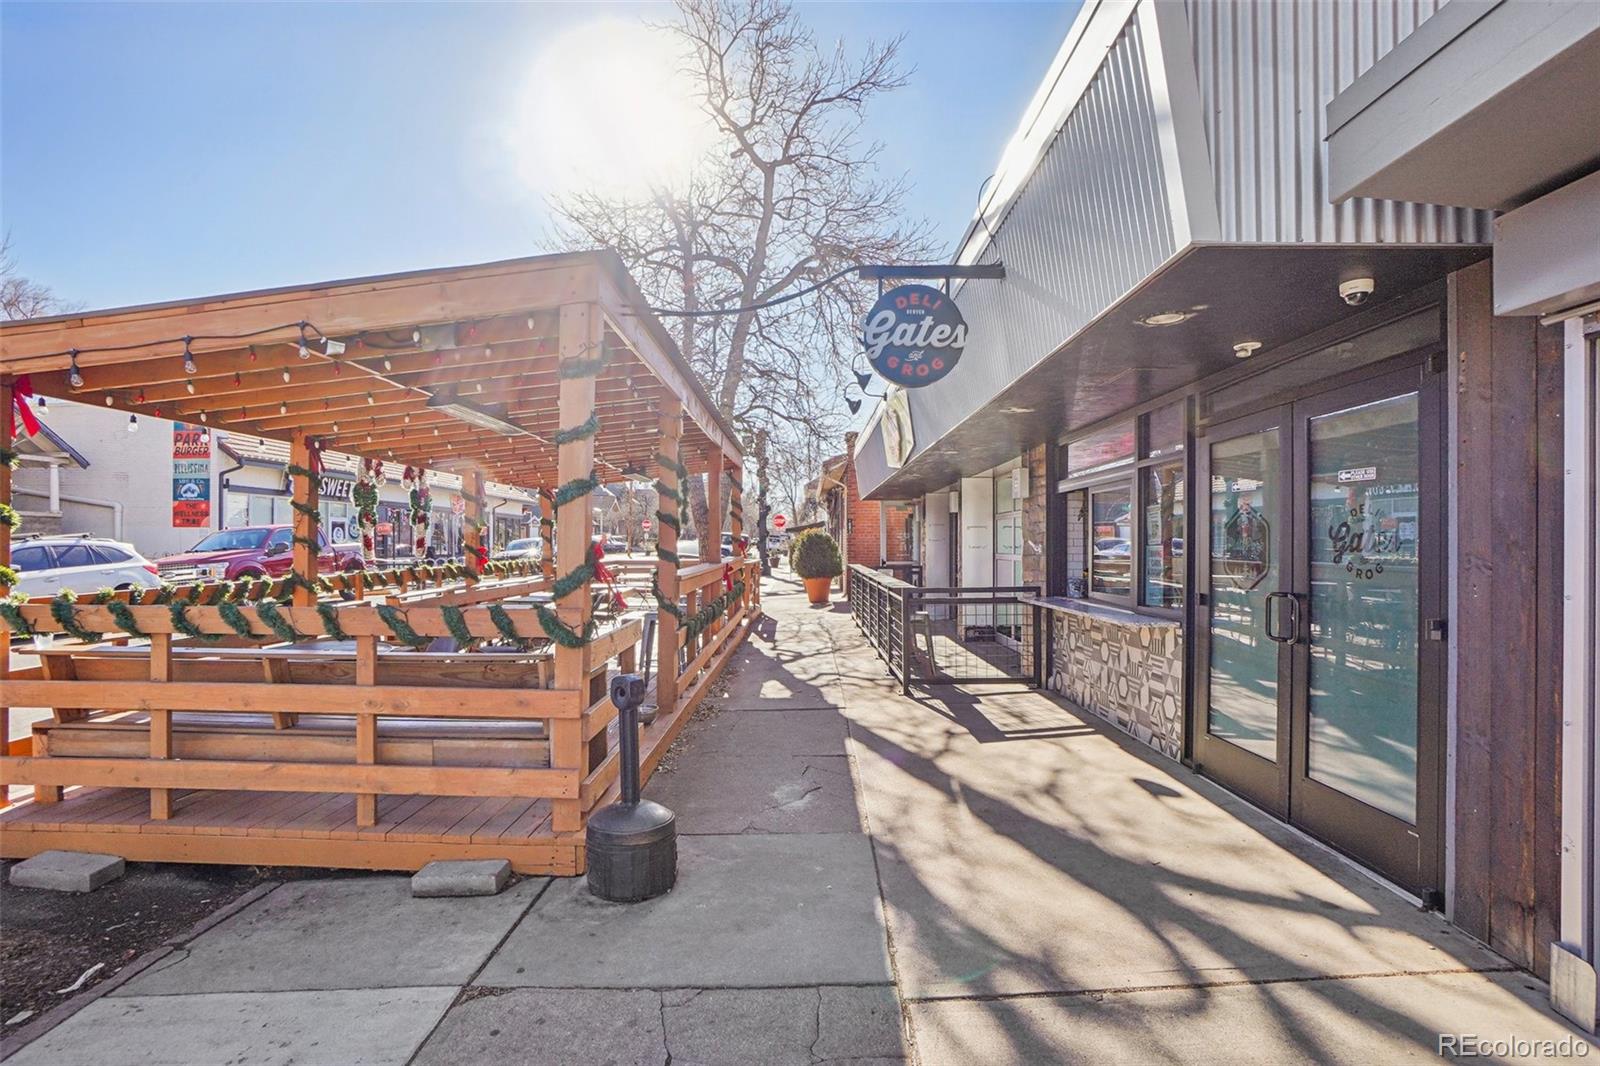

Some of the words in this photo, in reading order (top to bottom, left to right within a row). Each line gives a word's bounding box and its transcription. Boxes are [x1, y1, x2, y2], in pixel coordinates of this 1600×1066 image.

[896, 292, 942, 310] DELI
[862, 310, 967, 359] Gates
[887, 356, 944, 376] GROG
[174, 446, 209, 456] BURGER
[320, 477, 356, 497] SWEET
[1350, 503, 1381, 517] DELI
[1346, 562, 1384, 579] GROG
